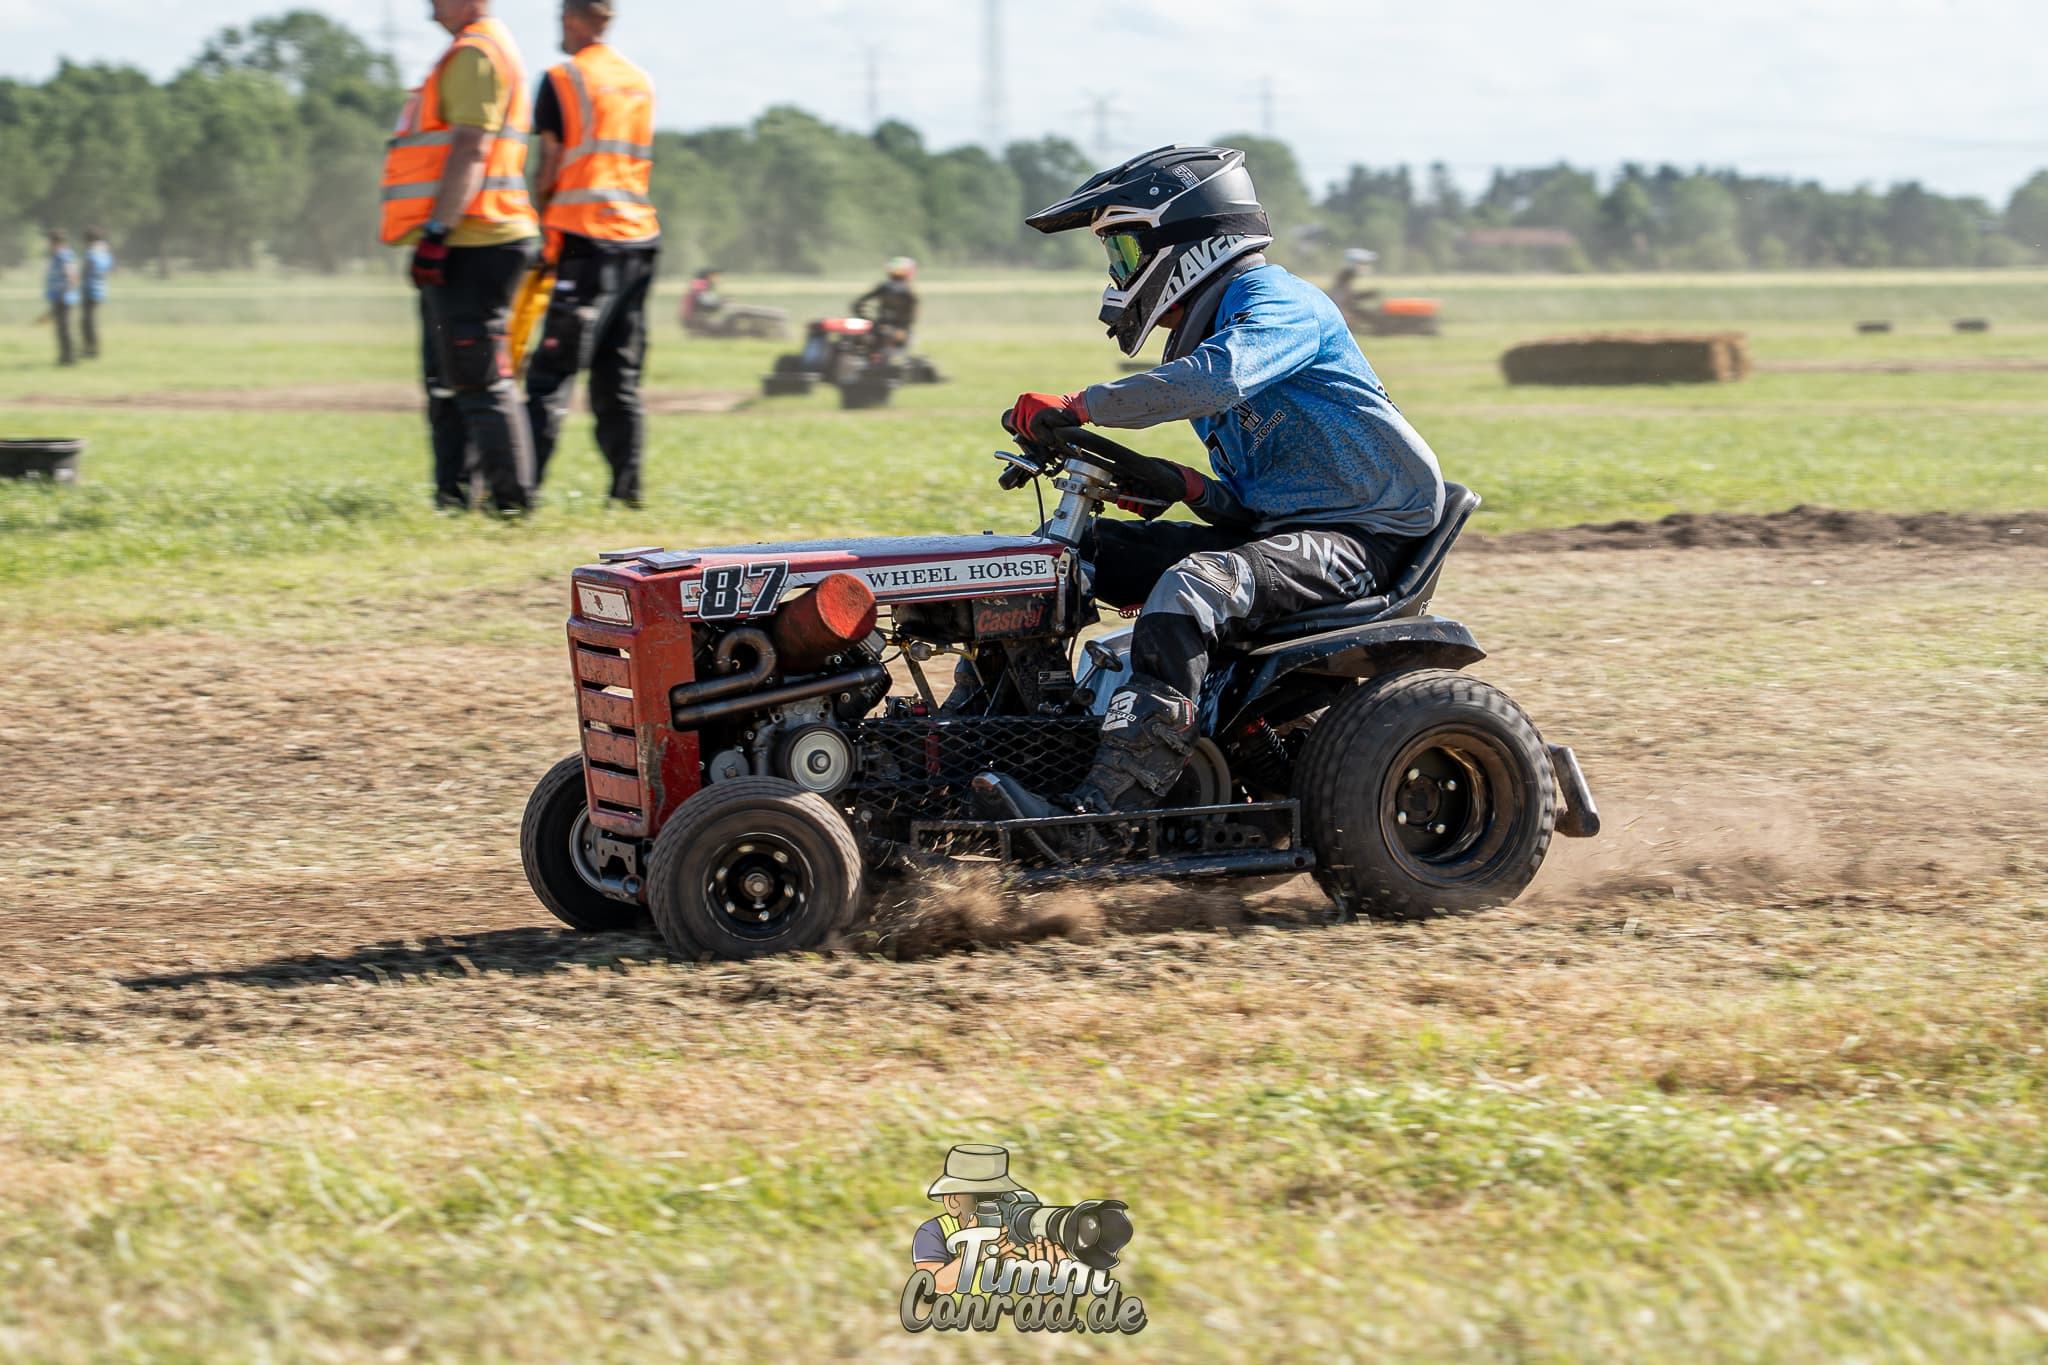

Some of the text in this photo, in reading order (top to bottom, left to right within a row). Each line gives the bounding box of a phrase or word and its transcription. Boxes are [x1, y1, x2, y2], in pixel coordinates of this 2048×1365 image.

[1247, 409, 1286, 457] CSTOPHER
[698, 560, 789, 619] 87
[866, 560, 1048, 588] WHEEL HORSE
[977, 604, 1044, 633] Castrol
